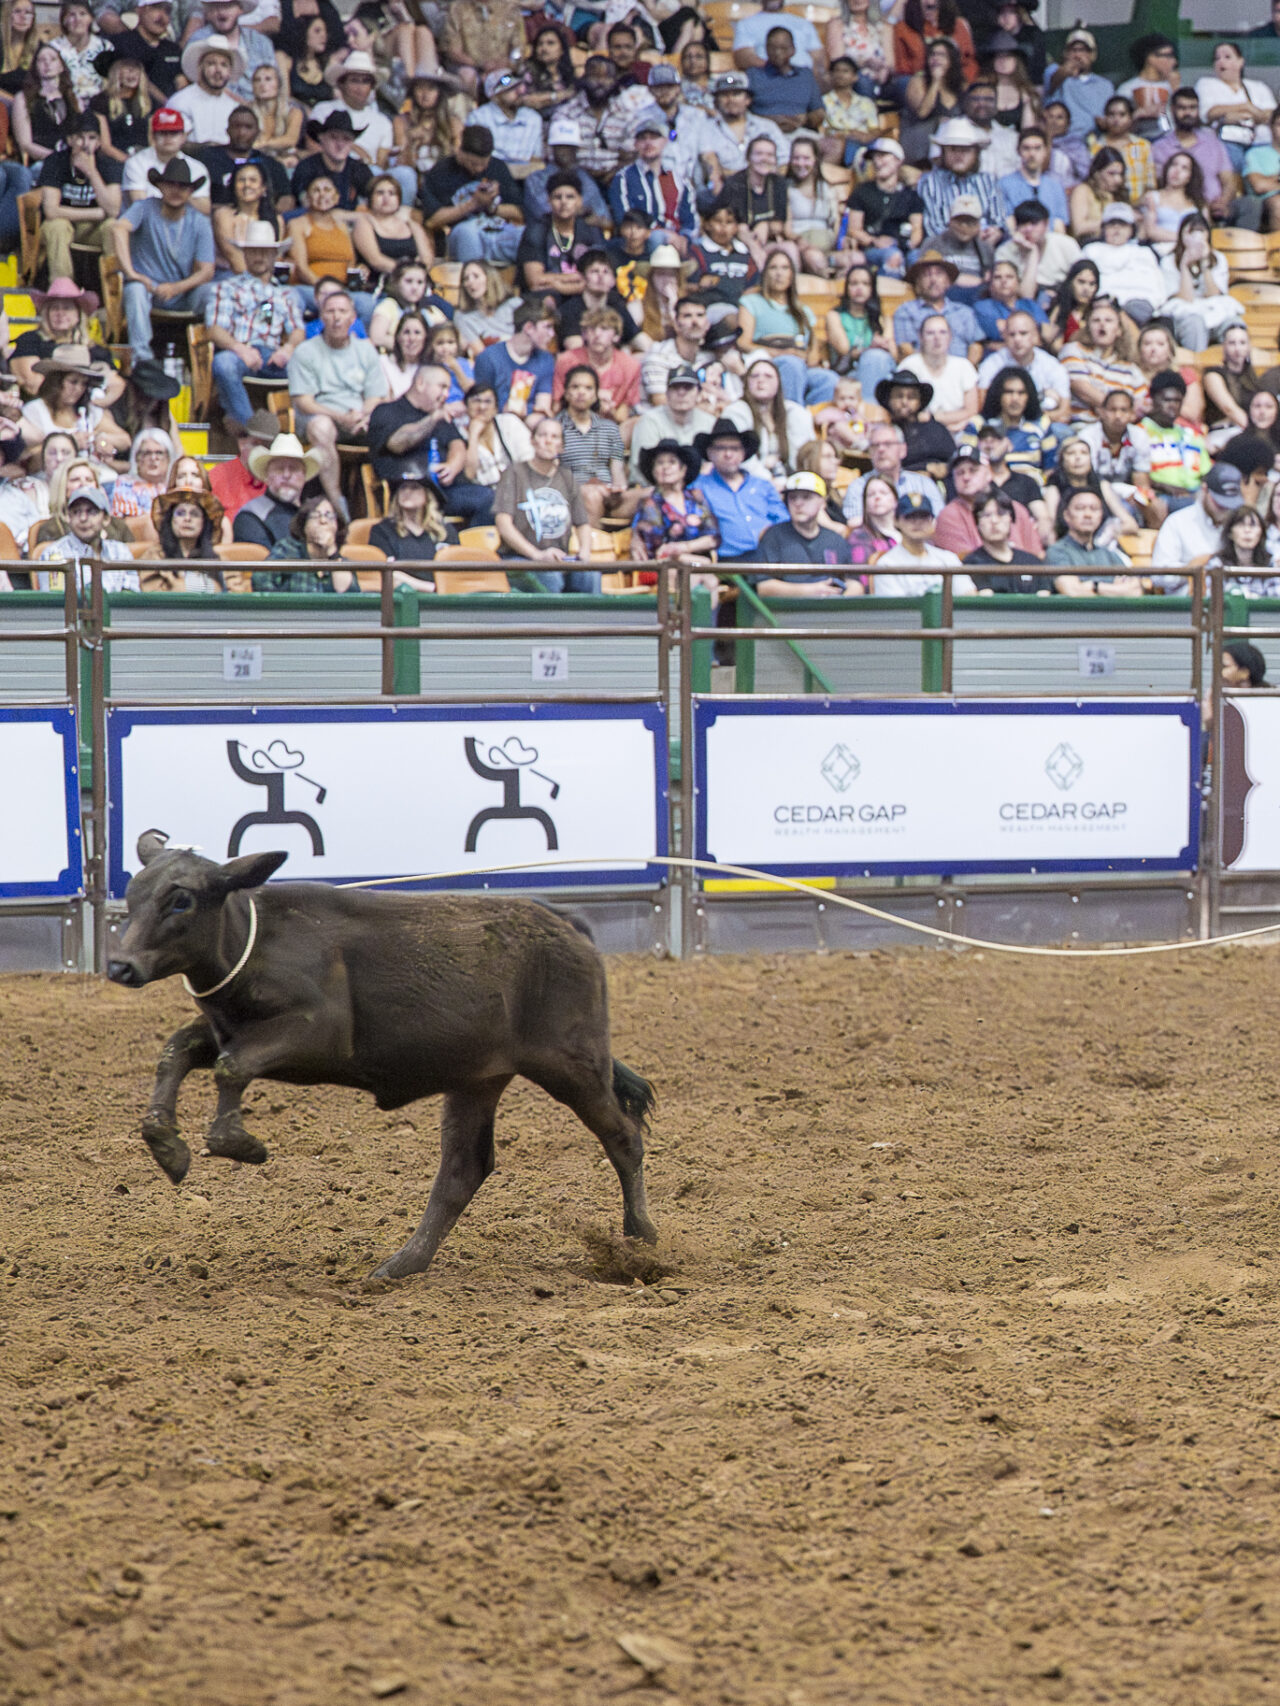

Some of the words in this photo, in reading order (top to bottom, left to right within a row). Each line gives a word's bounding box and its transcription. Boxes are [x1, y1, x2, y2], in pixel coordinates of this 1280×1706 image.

[774, 805, 855, 823] CEDAR
[858, 804, 907, 822] GAP
[999, 803, 1077, 820] CEDAR
[1080, 802, 1127, 820] GAP
